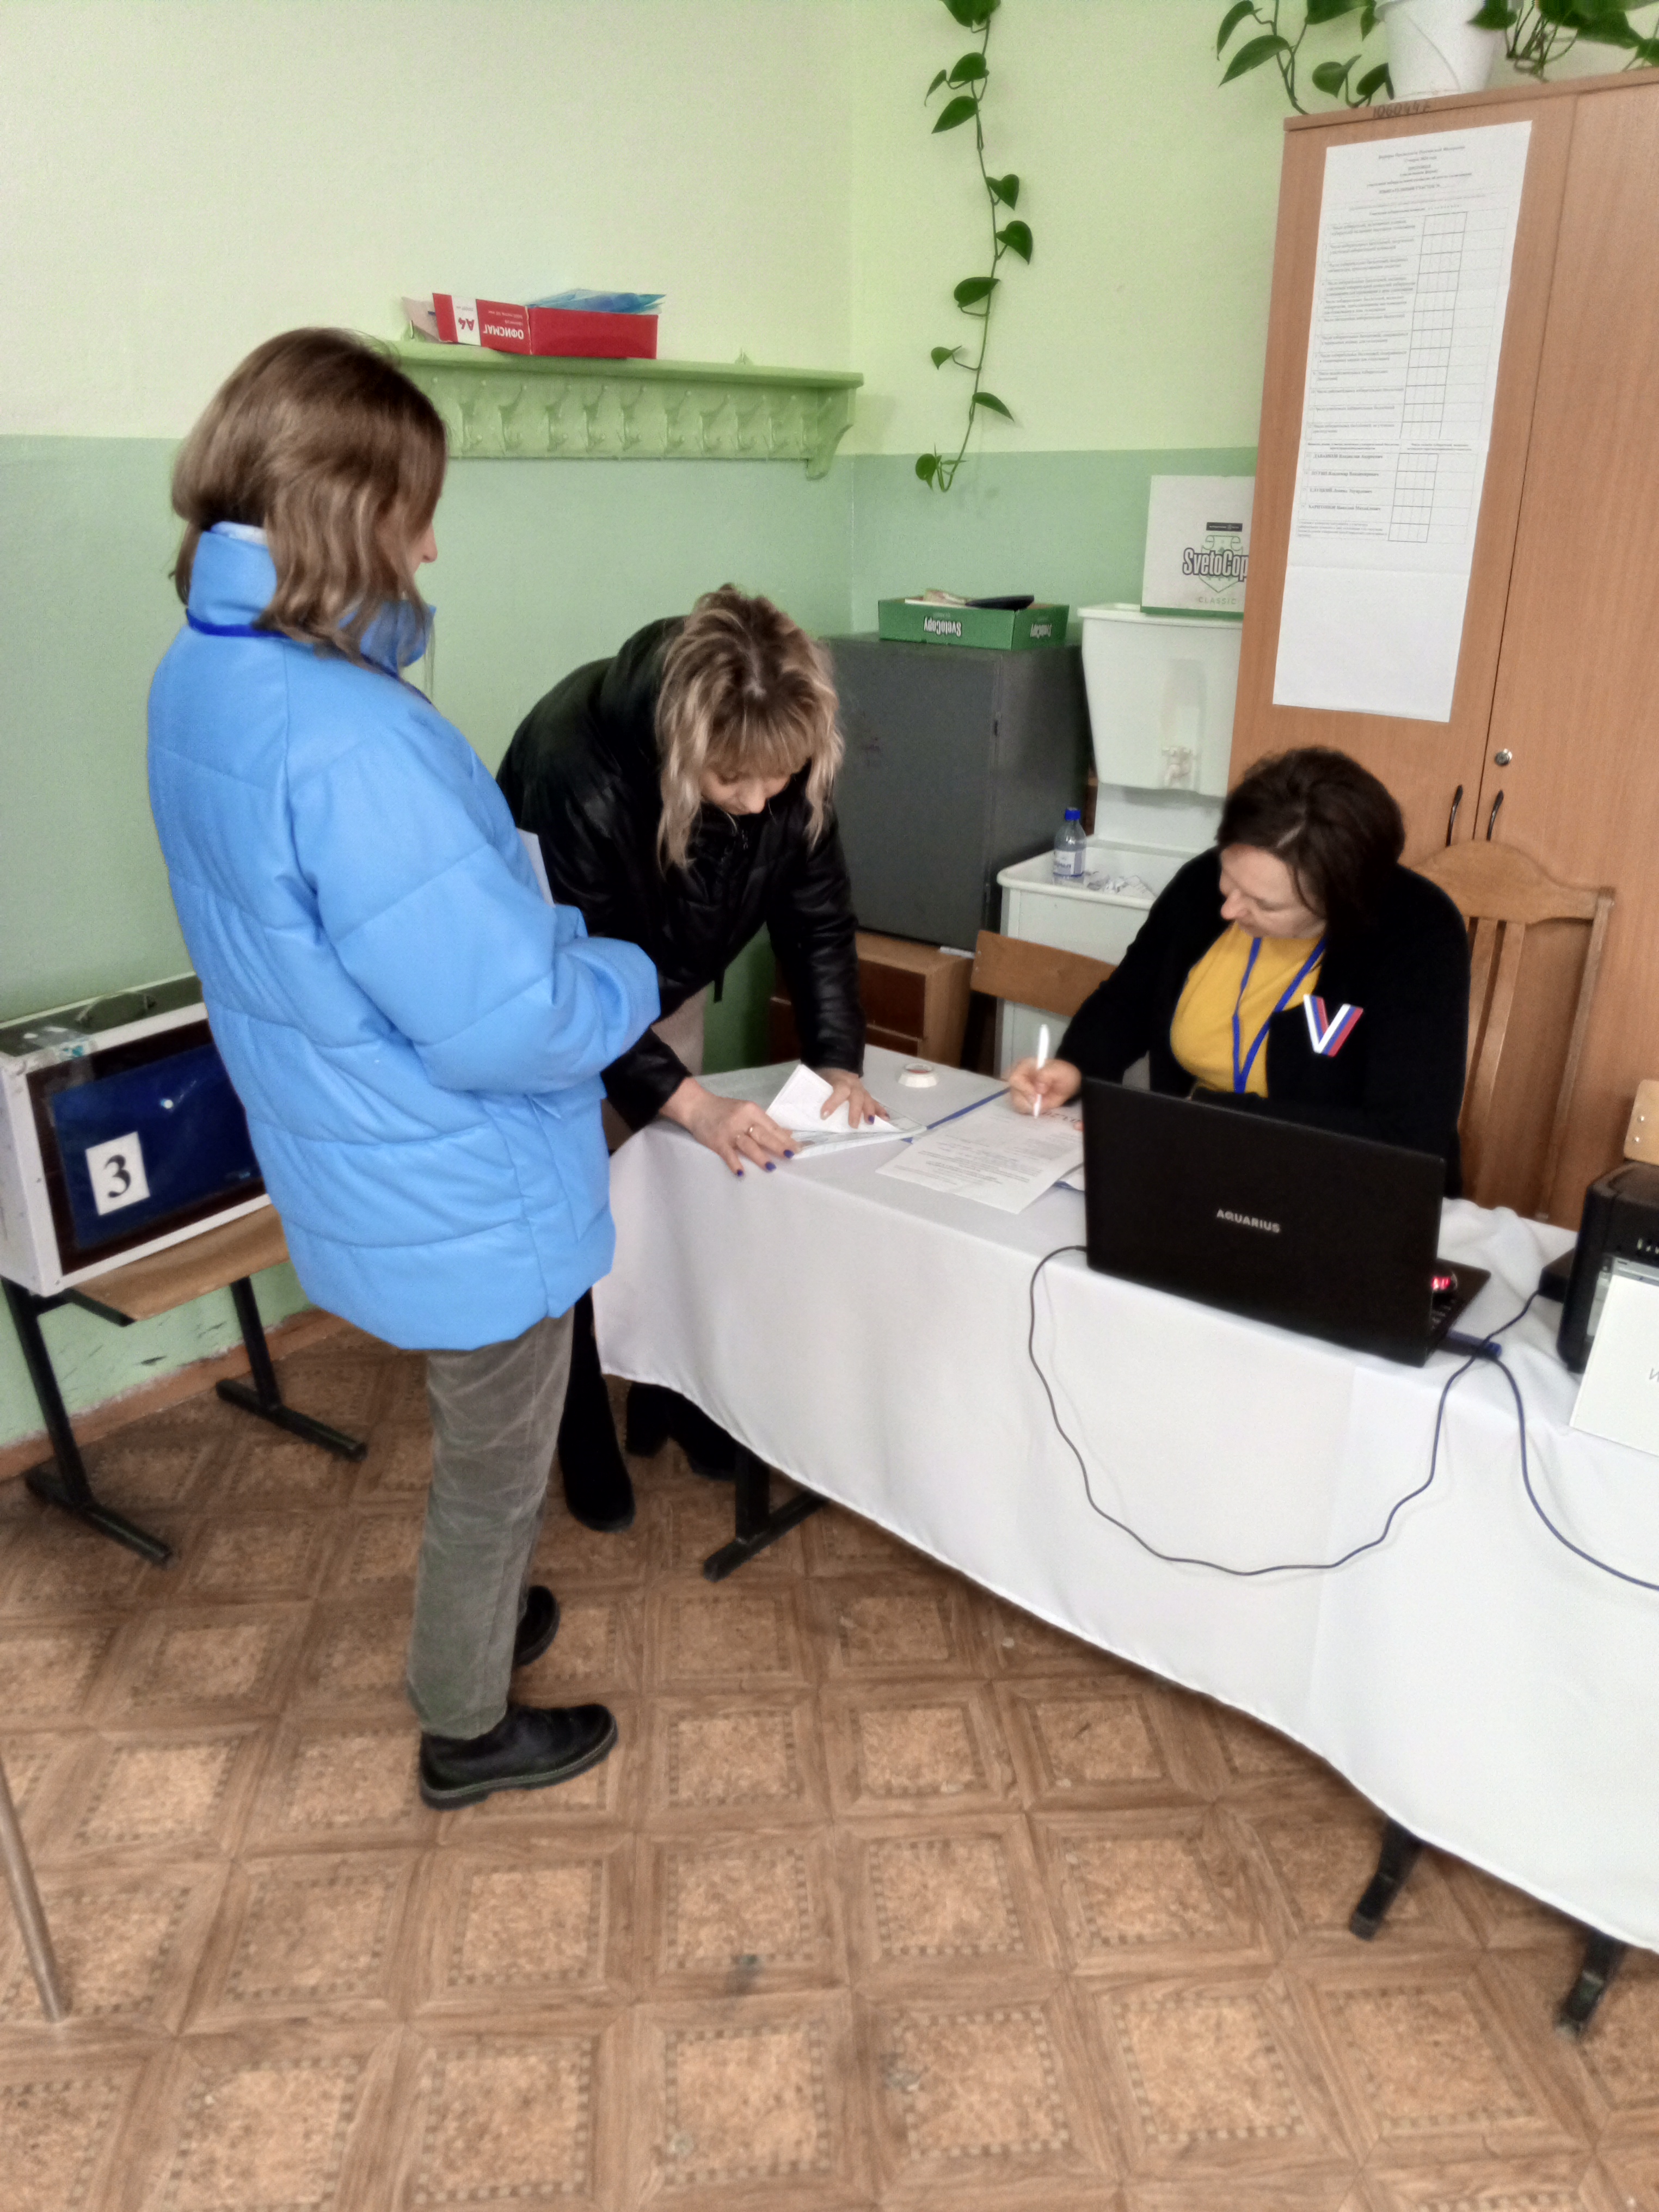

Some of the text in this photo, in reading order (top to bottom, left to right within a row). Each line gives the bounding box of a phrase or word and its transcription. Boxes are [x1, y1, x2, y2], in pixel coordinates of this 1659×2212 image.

[458, 317, 475, 331] A4
[483, 324, 524, 340] ОФИСМАГ
[1182, 548, 1249, 582] SvetoCop
[1199, 597, 1237, 605] CLASSIC
[924, 616, 962, 637] SvetoCopy
[103, 1154, 131, 1198] 3
[1216, 1209, 1280, 1233] AQUARIUS
